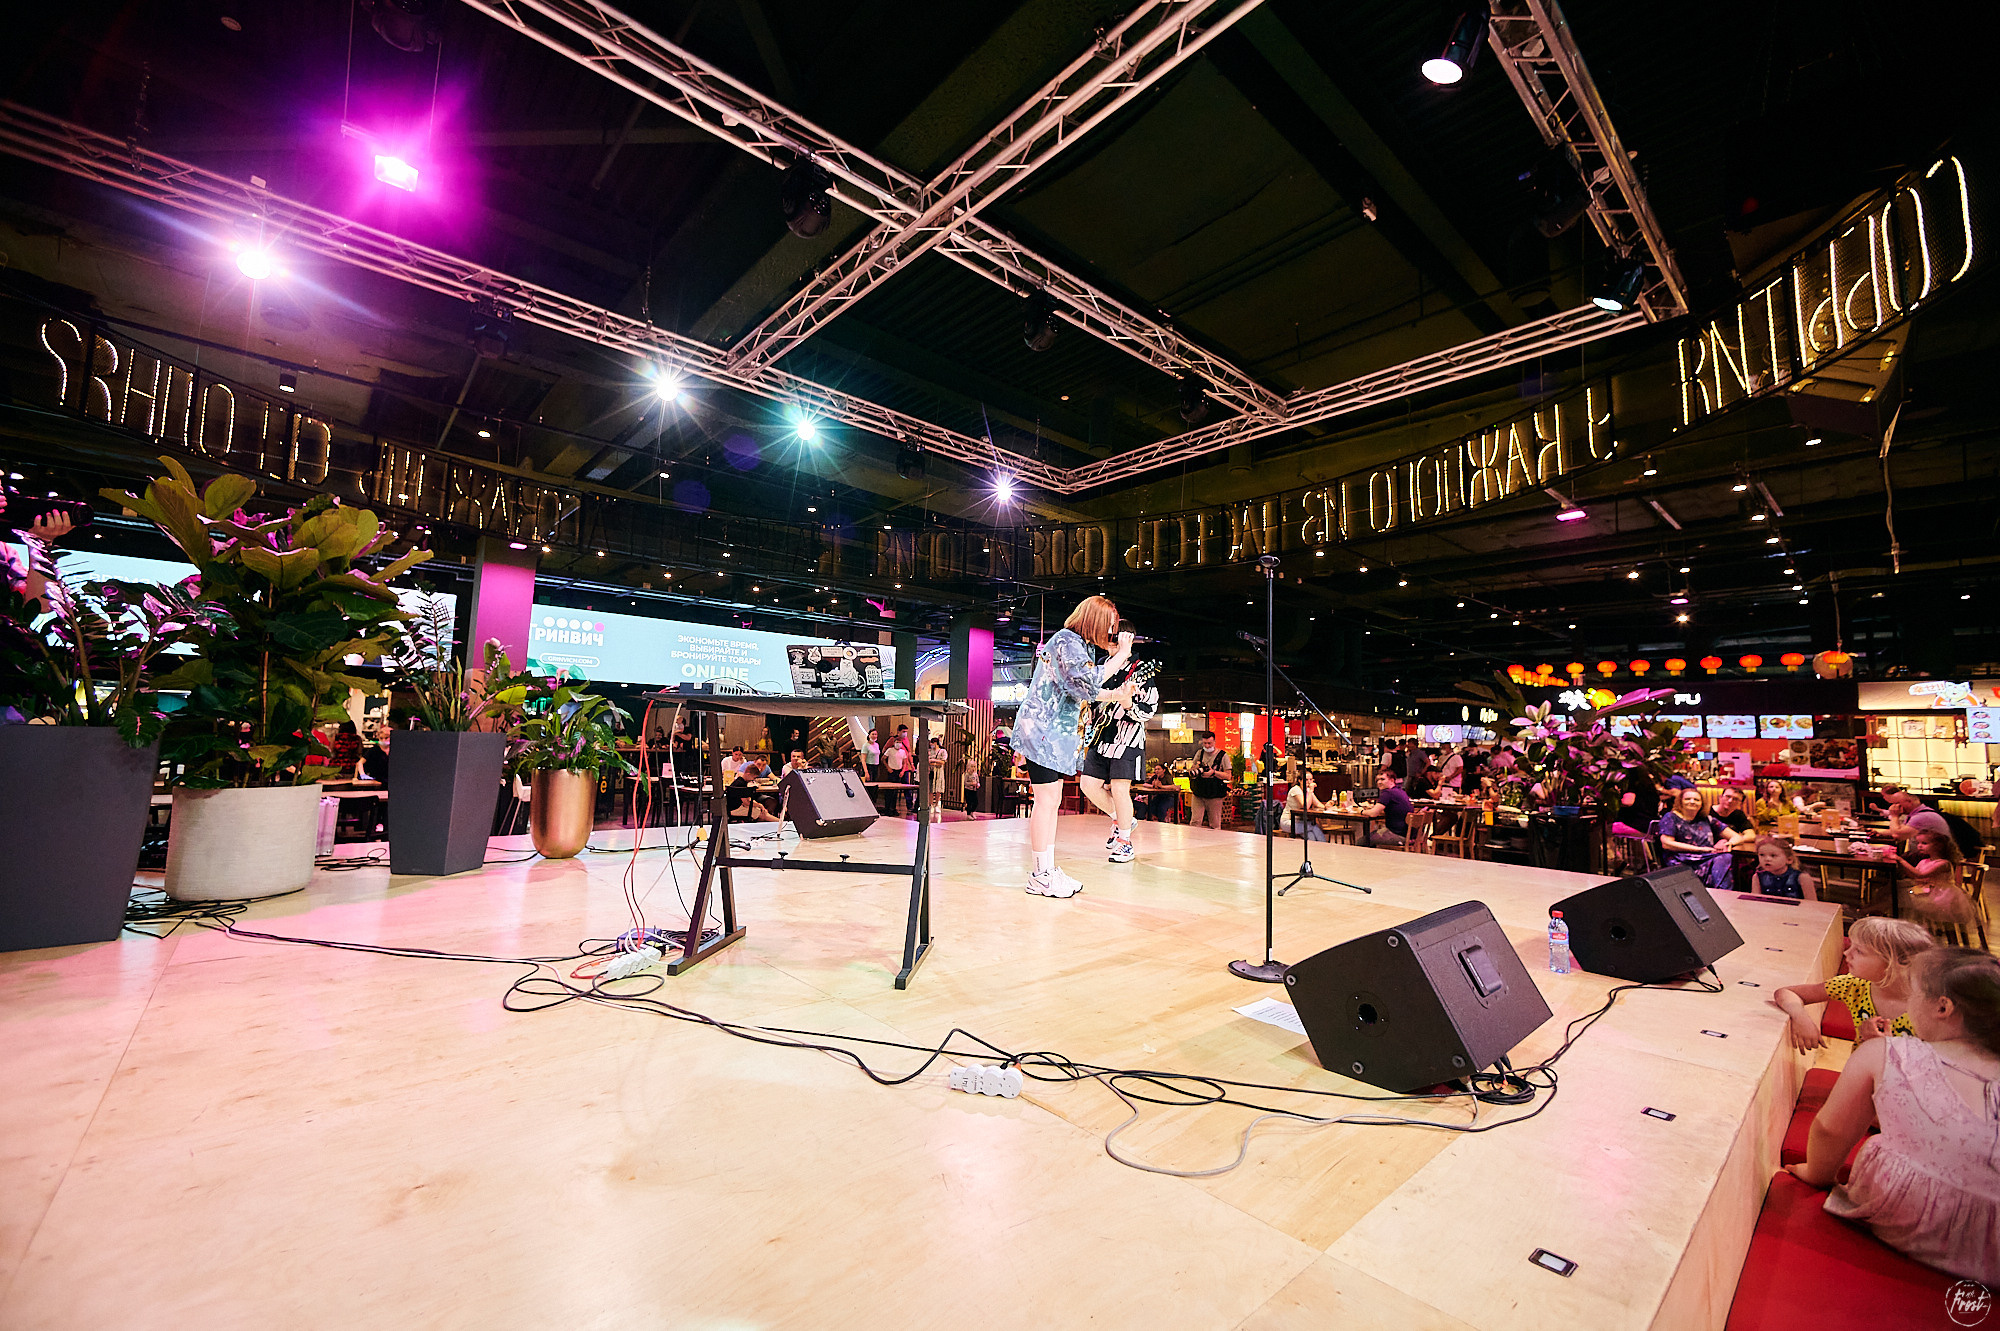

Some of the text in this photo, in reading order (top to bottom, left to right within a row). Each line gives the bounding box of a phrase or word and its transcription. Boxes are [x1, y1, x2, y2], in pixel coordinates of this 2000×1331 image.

[677, 635, 760, 651] ЭКОНОМЬТЕ ВРЕМЯ,
[689, 644, 748, 657] ВЫБИРАЙТЕ И
[670, 650, 761, 666] БРОНИРУЙТЕ ТОВАРЫ
[681, 663, 749, 681] ONLINE
